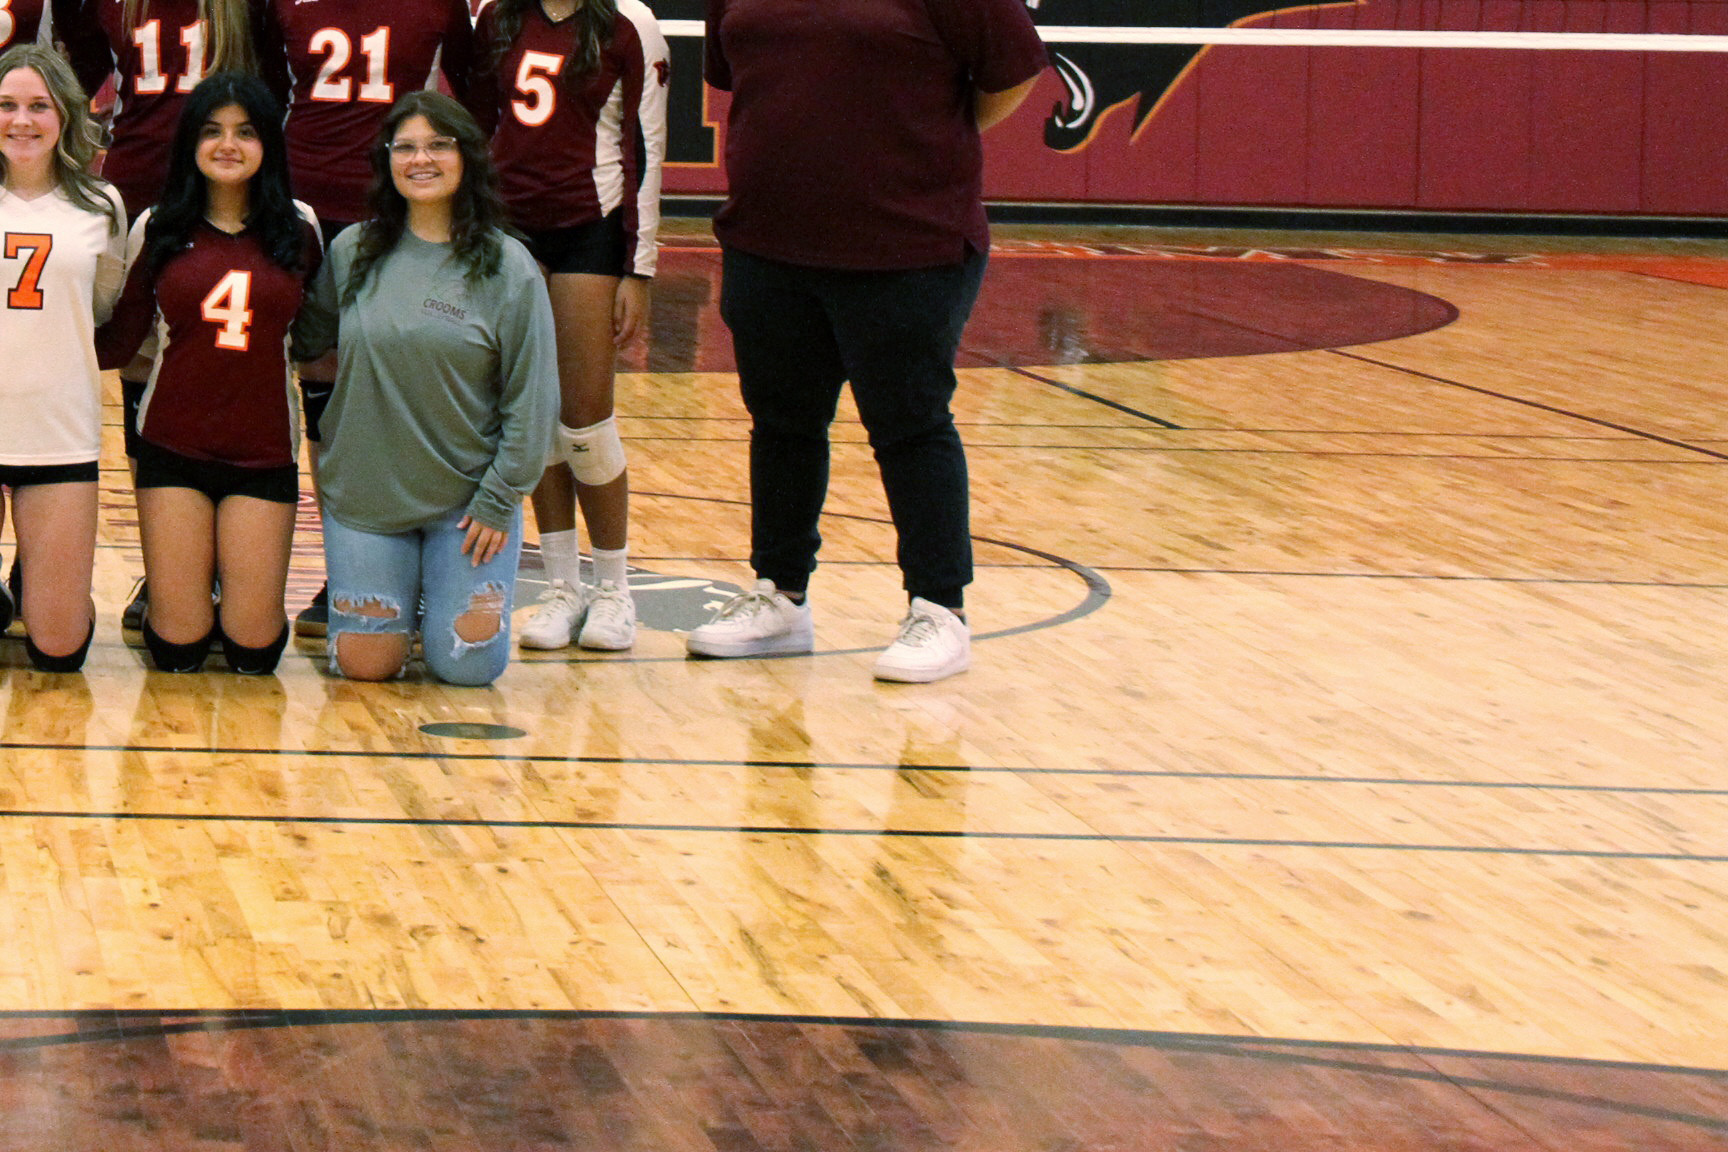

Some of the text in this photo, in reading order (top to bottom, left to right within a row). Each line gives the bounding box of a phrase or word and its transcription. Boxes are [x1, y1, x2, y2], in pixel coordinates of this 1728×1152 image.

[133, 18, 211, 95] 11
[308, 25, 394, 102] 21
[511, 49, 565, 128] 5
[3, 231, 53, 310] 7
[423, 298, 467, 320] CROOMS
[201, 269, 254, 352] 4
